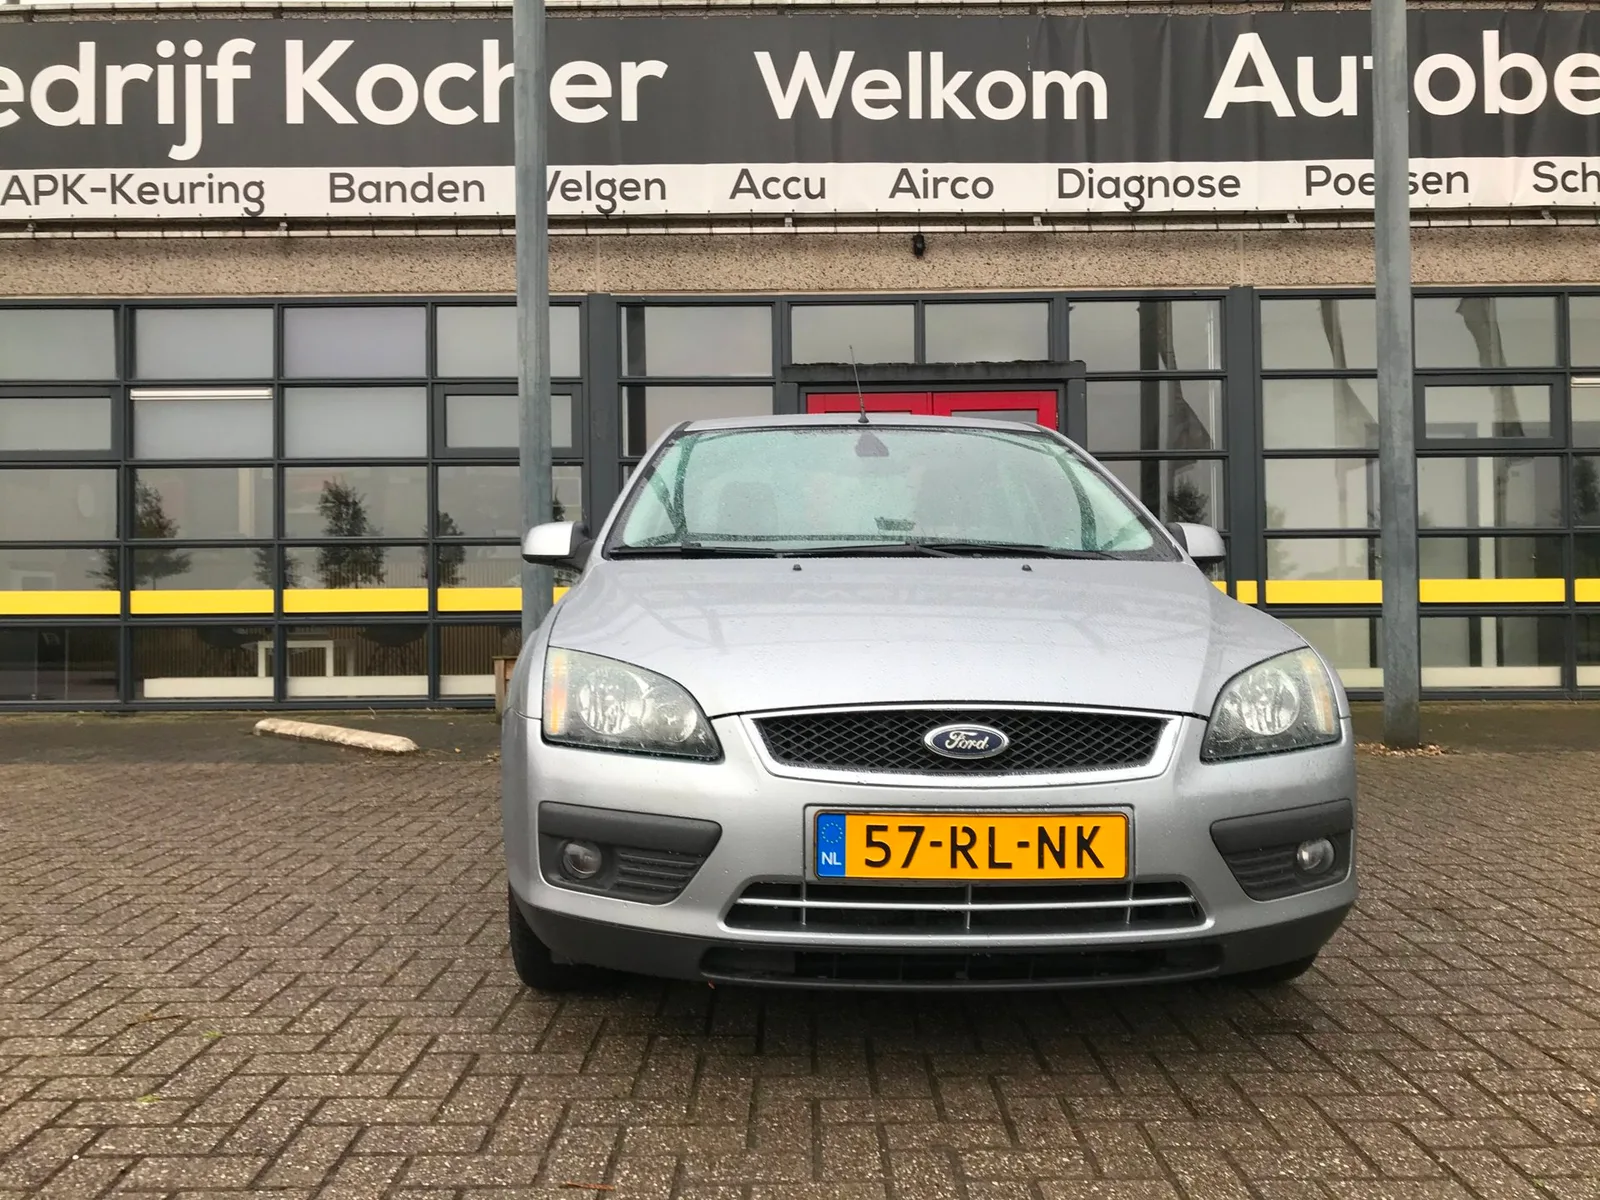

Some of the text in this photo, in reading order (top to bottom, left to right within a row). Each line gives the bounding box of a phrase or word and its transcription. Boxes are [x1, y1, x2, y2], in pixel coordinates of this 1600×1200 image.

[286, 40, 668, 125] Kocher
[754, 50, 1107, 120] Welkom
[1204, 30, 1600, 118] Auobe
[1, 173, 265, 216] APK-Keuring
[330, 172, 485, 204] Banden
[730, 168, 826, 200] Accu
[889, 167, 994, 200] Airco
[1058, 168, 1241, 211] Diagnose
[1306, 165, 1468, 196] Poesen
[1533, 160, 1600, 193] Sch
[945, 731, 989, 749] Ford
[822, 852, 841, 865] NL
[865, 825, 1104, 869] 57-RL-NK
